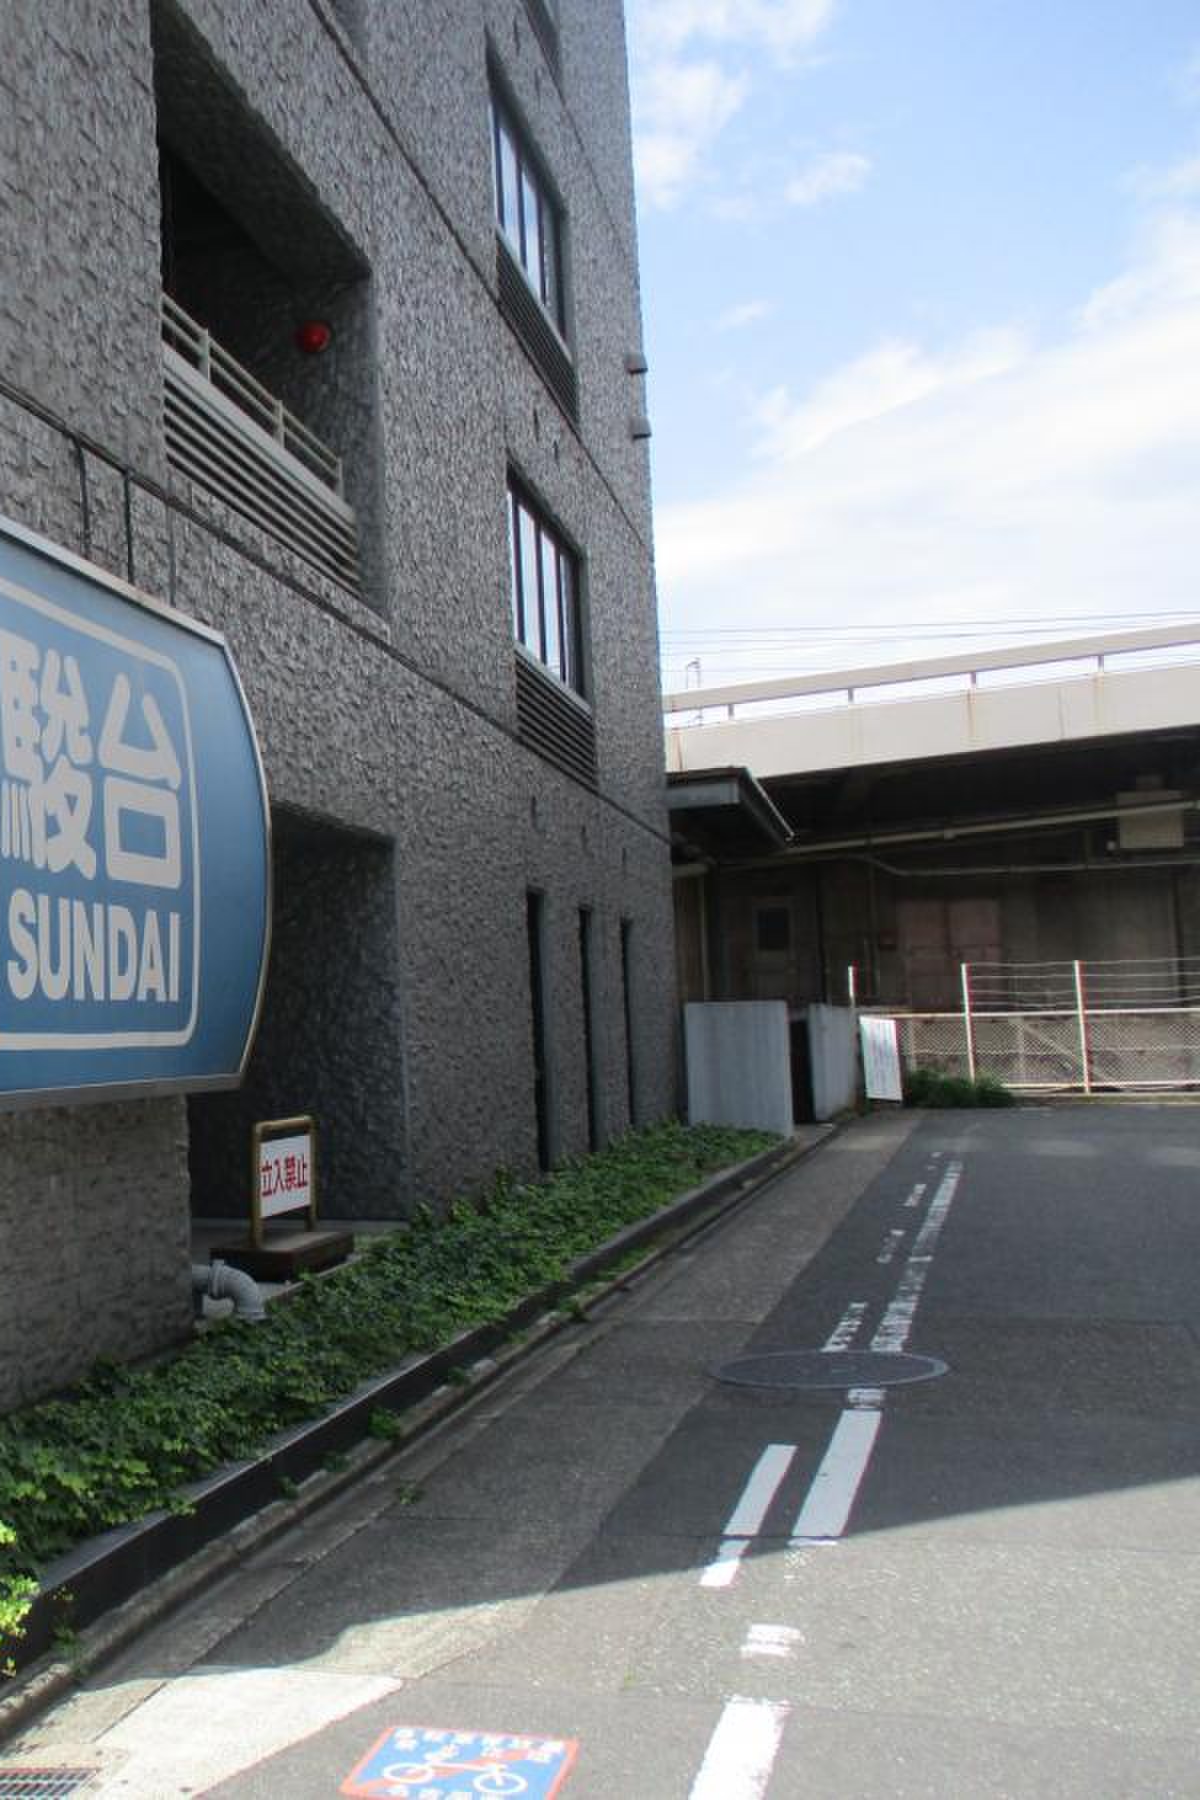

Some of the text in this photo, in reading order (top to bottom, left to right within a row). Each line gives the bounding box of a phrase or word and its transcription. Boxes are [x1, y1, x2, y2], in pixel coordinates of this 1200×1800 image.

[7, 888, 180, 1003] SUNDAI
[260, 1151, 308, 1198] 立入禁止
